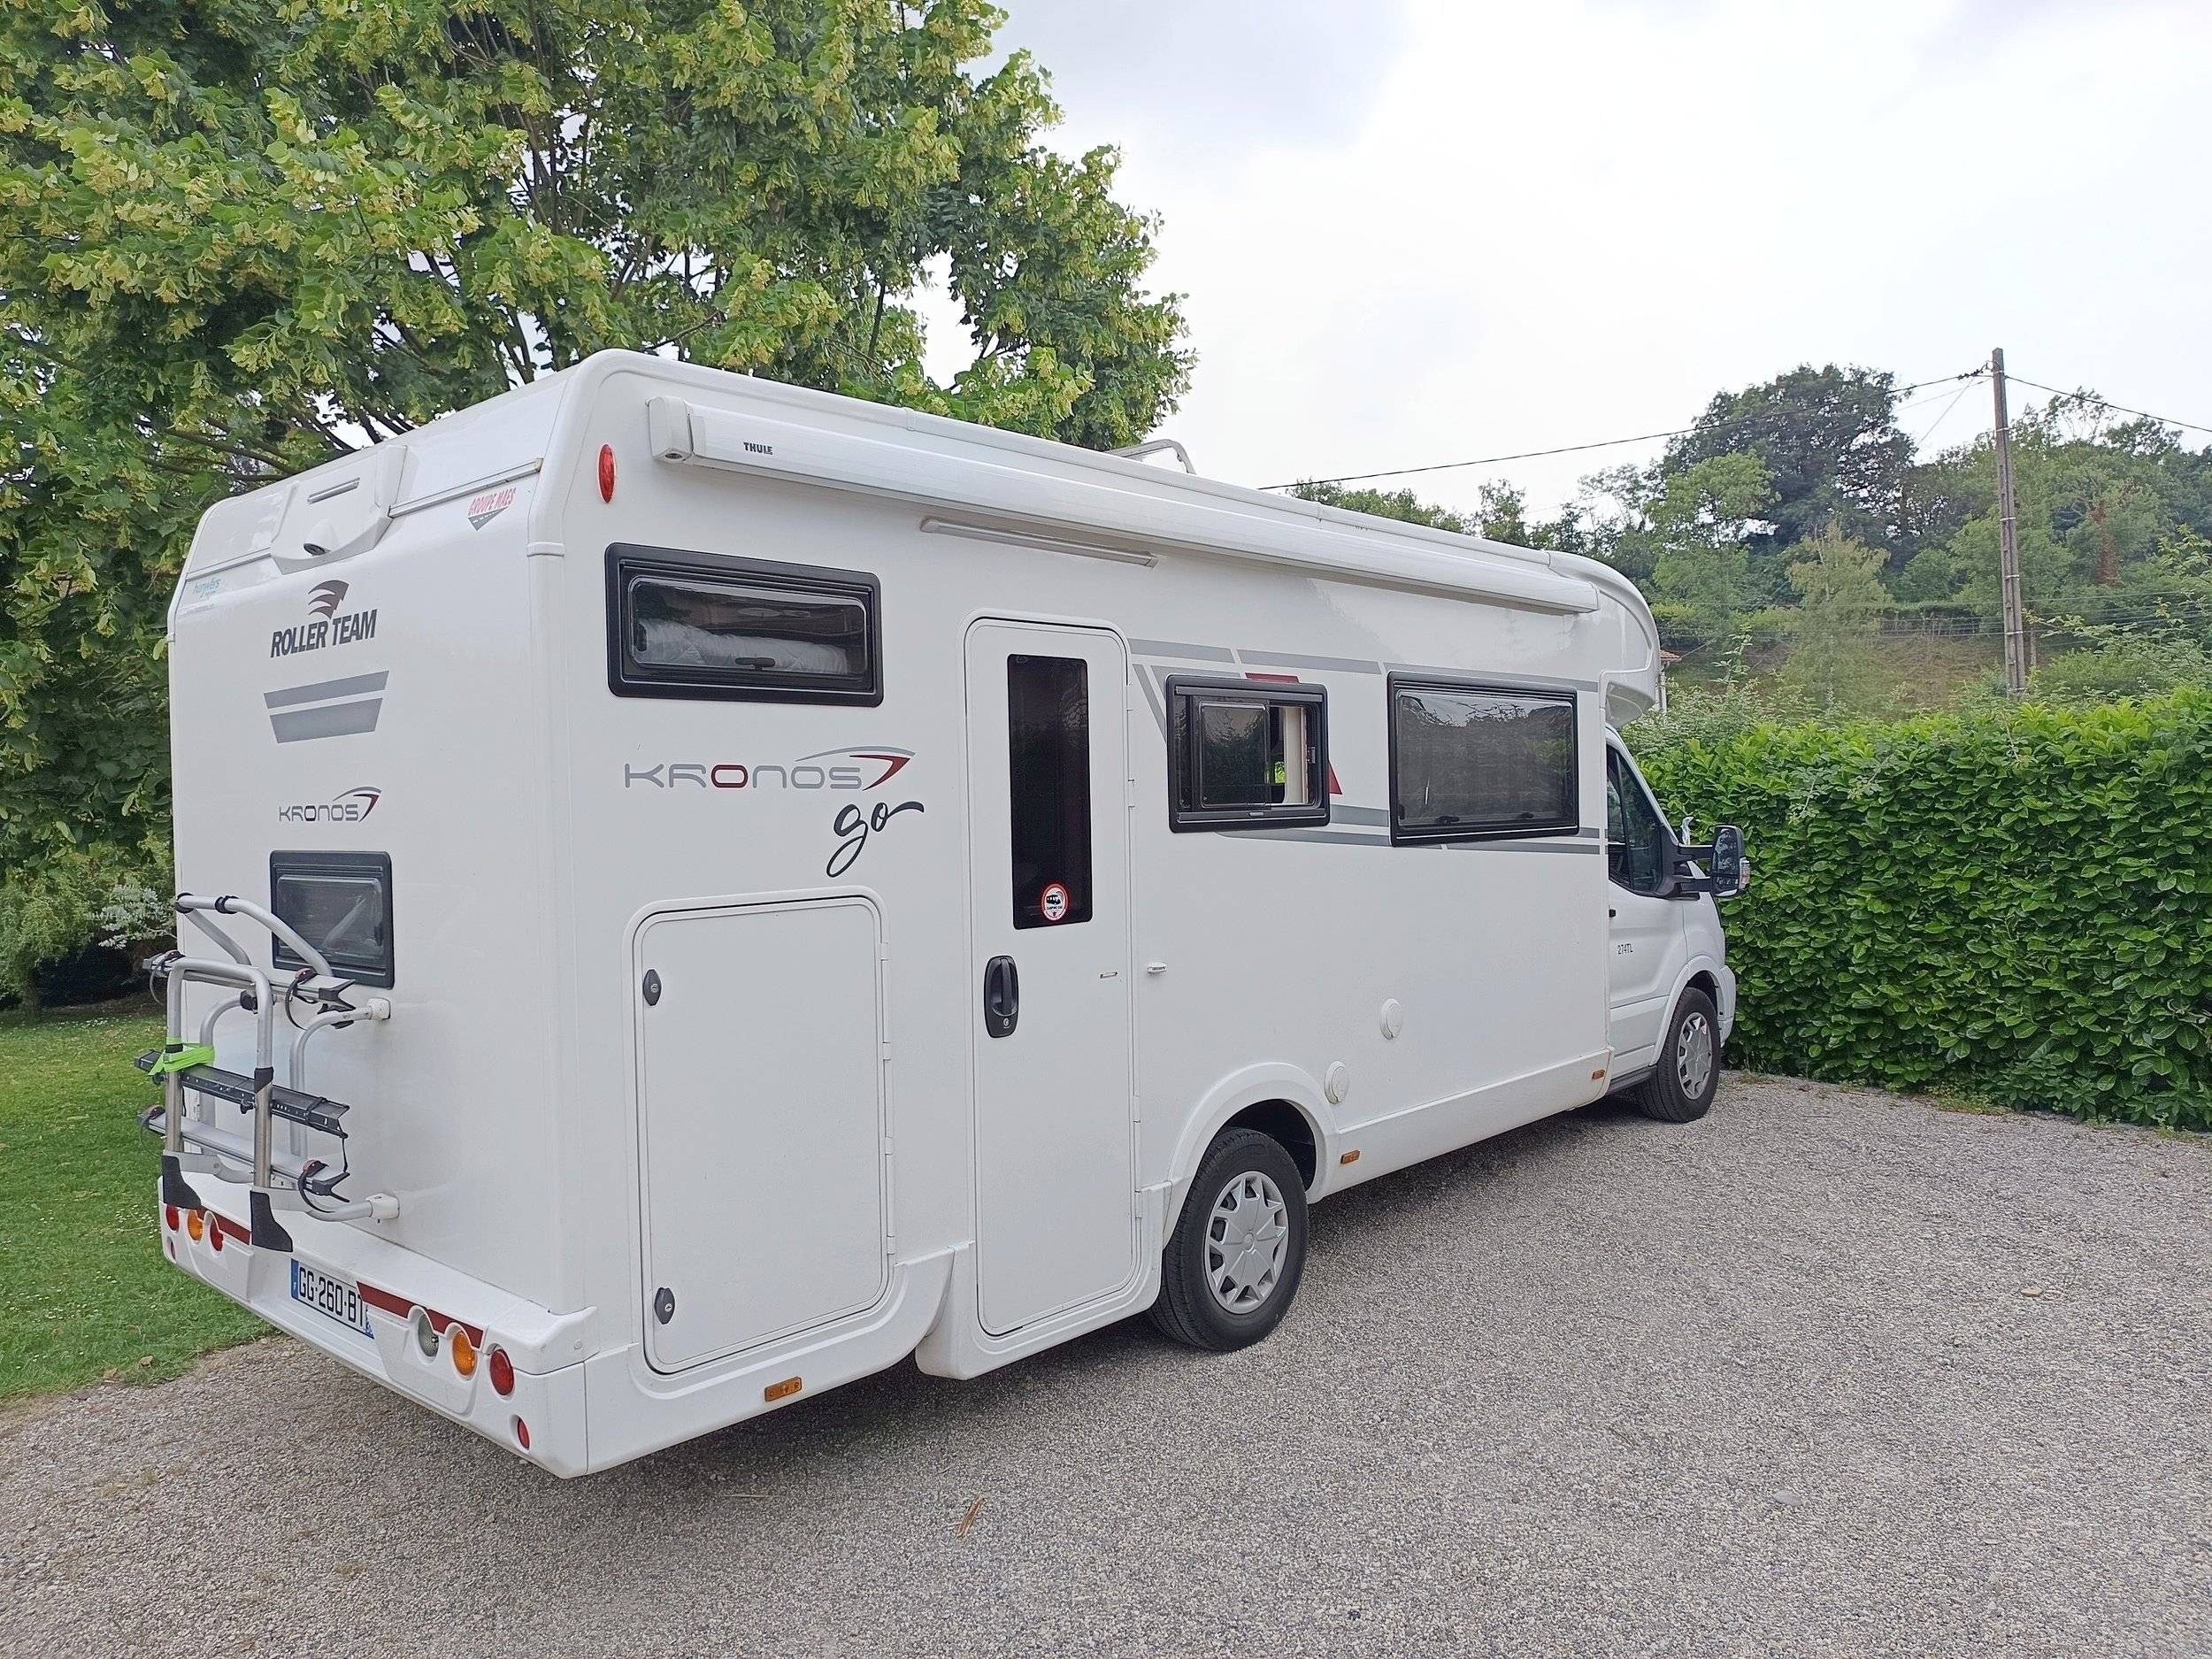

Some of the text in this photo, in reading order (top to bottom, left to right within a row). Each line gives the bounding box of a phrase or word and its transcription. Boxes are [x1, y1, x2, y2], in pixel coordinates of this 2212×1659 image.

[743, 442, 773, 456] THULE
[270, 609, 378, 658] ROLLER TEAM
[625, 763, 863, 790] KRONOS
[279, 803, 359, 822] KRONOS
[826, 801, 925, 878] go
